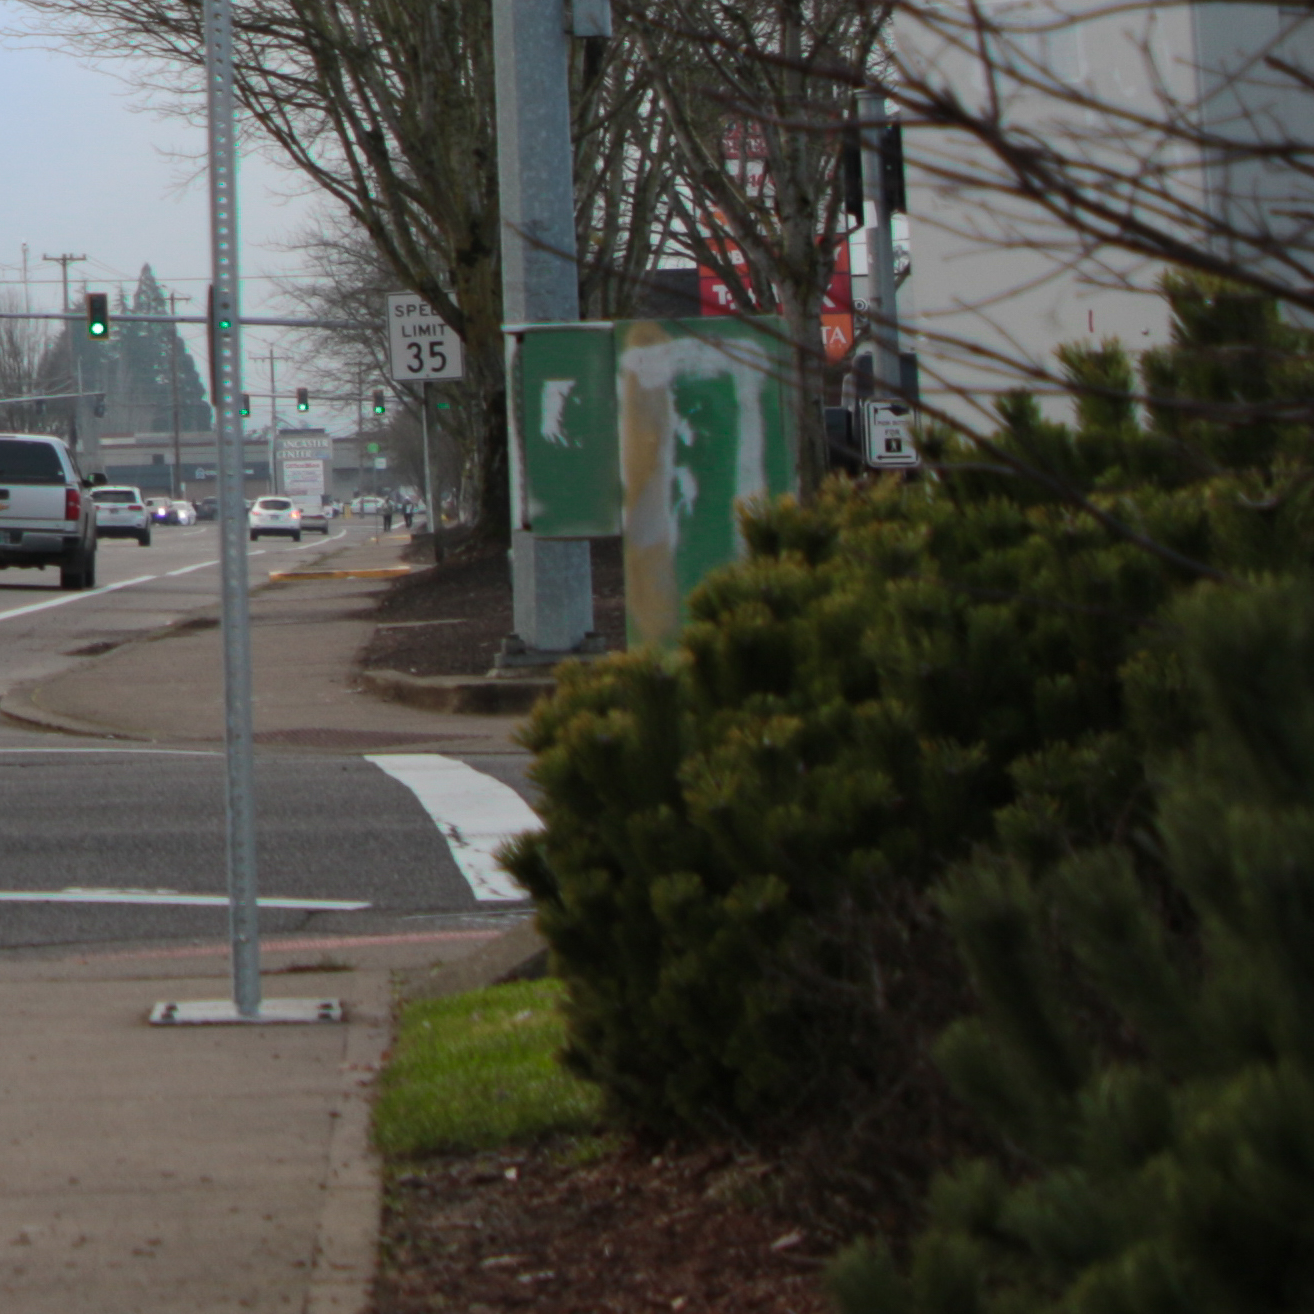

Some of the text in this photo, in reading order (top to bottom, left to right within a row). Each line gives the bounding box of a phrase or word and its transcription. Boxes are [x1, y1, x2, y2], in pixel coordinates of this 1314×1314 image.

[395, 304, 441, 317] SPE
[402, 323, 448, 338] LIMIT
[406, 341, 447, 373] 35
[281, 439, 329, 448] ANCASTER
